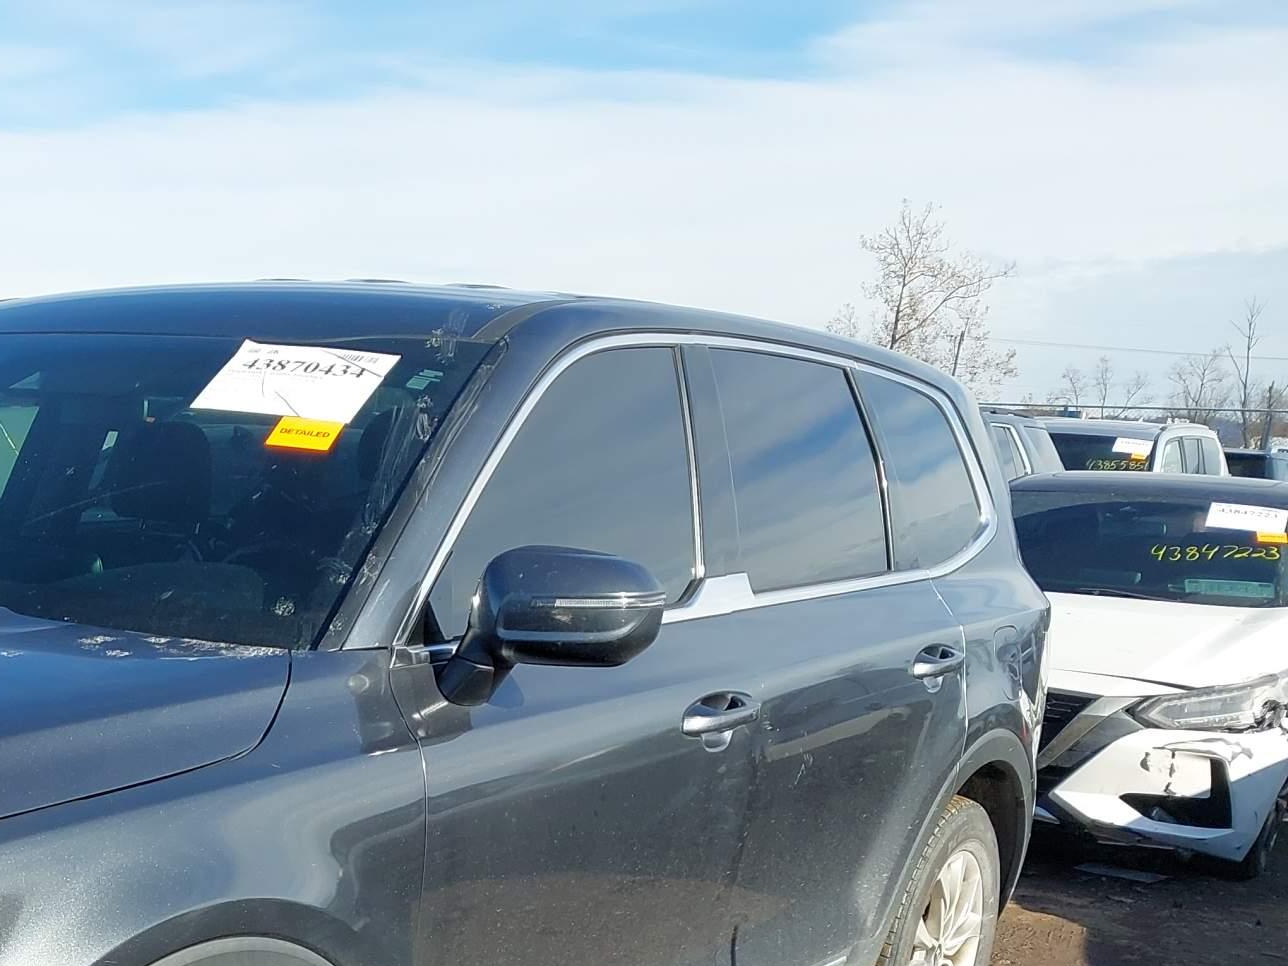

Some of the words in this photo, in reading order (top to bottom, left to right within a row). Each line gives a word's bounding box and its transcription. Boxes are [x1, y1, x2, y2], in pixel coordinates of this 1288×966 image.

[242, 358, 366, 379] 43870434
[279, 427, 331, 438] DETAILED
[1151, 543, 1281, 561] 43847223
